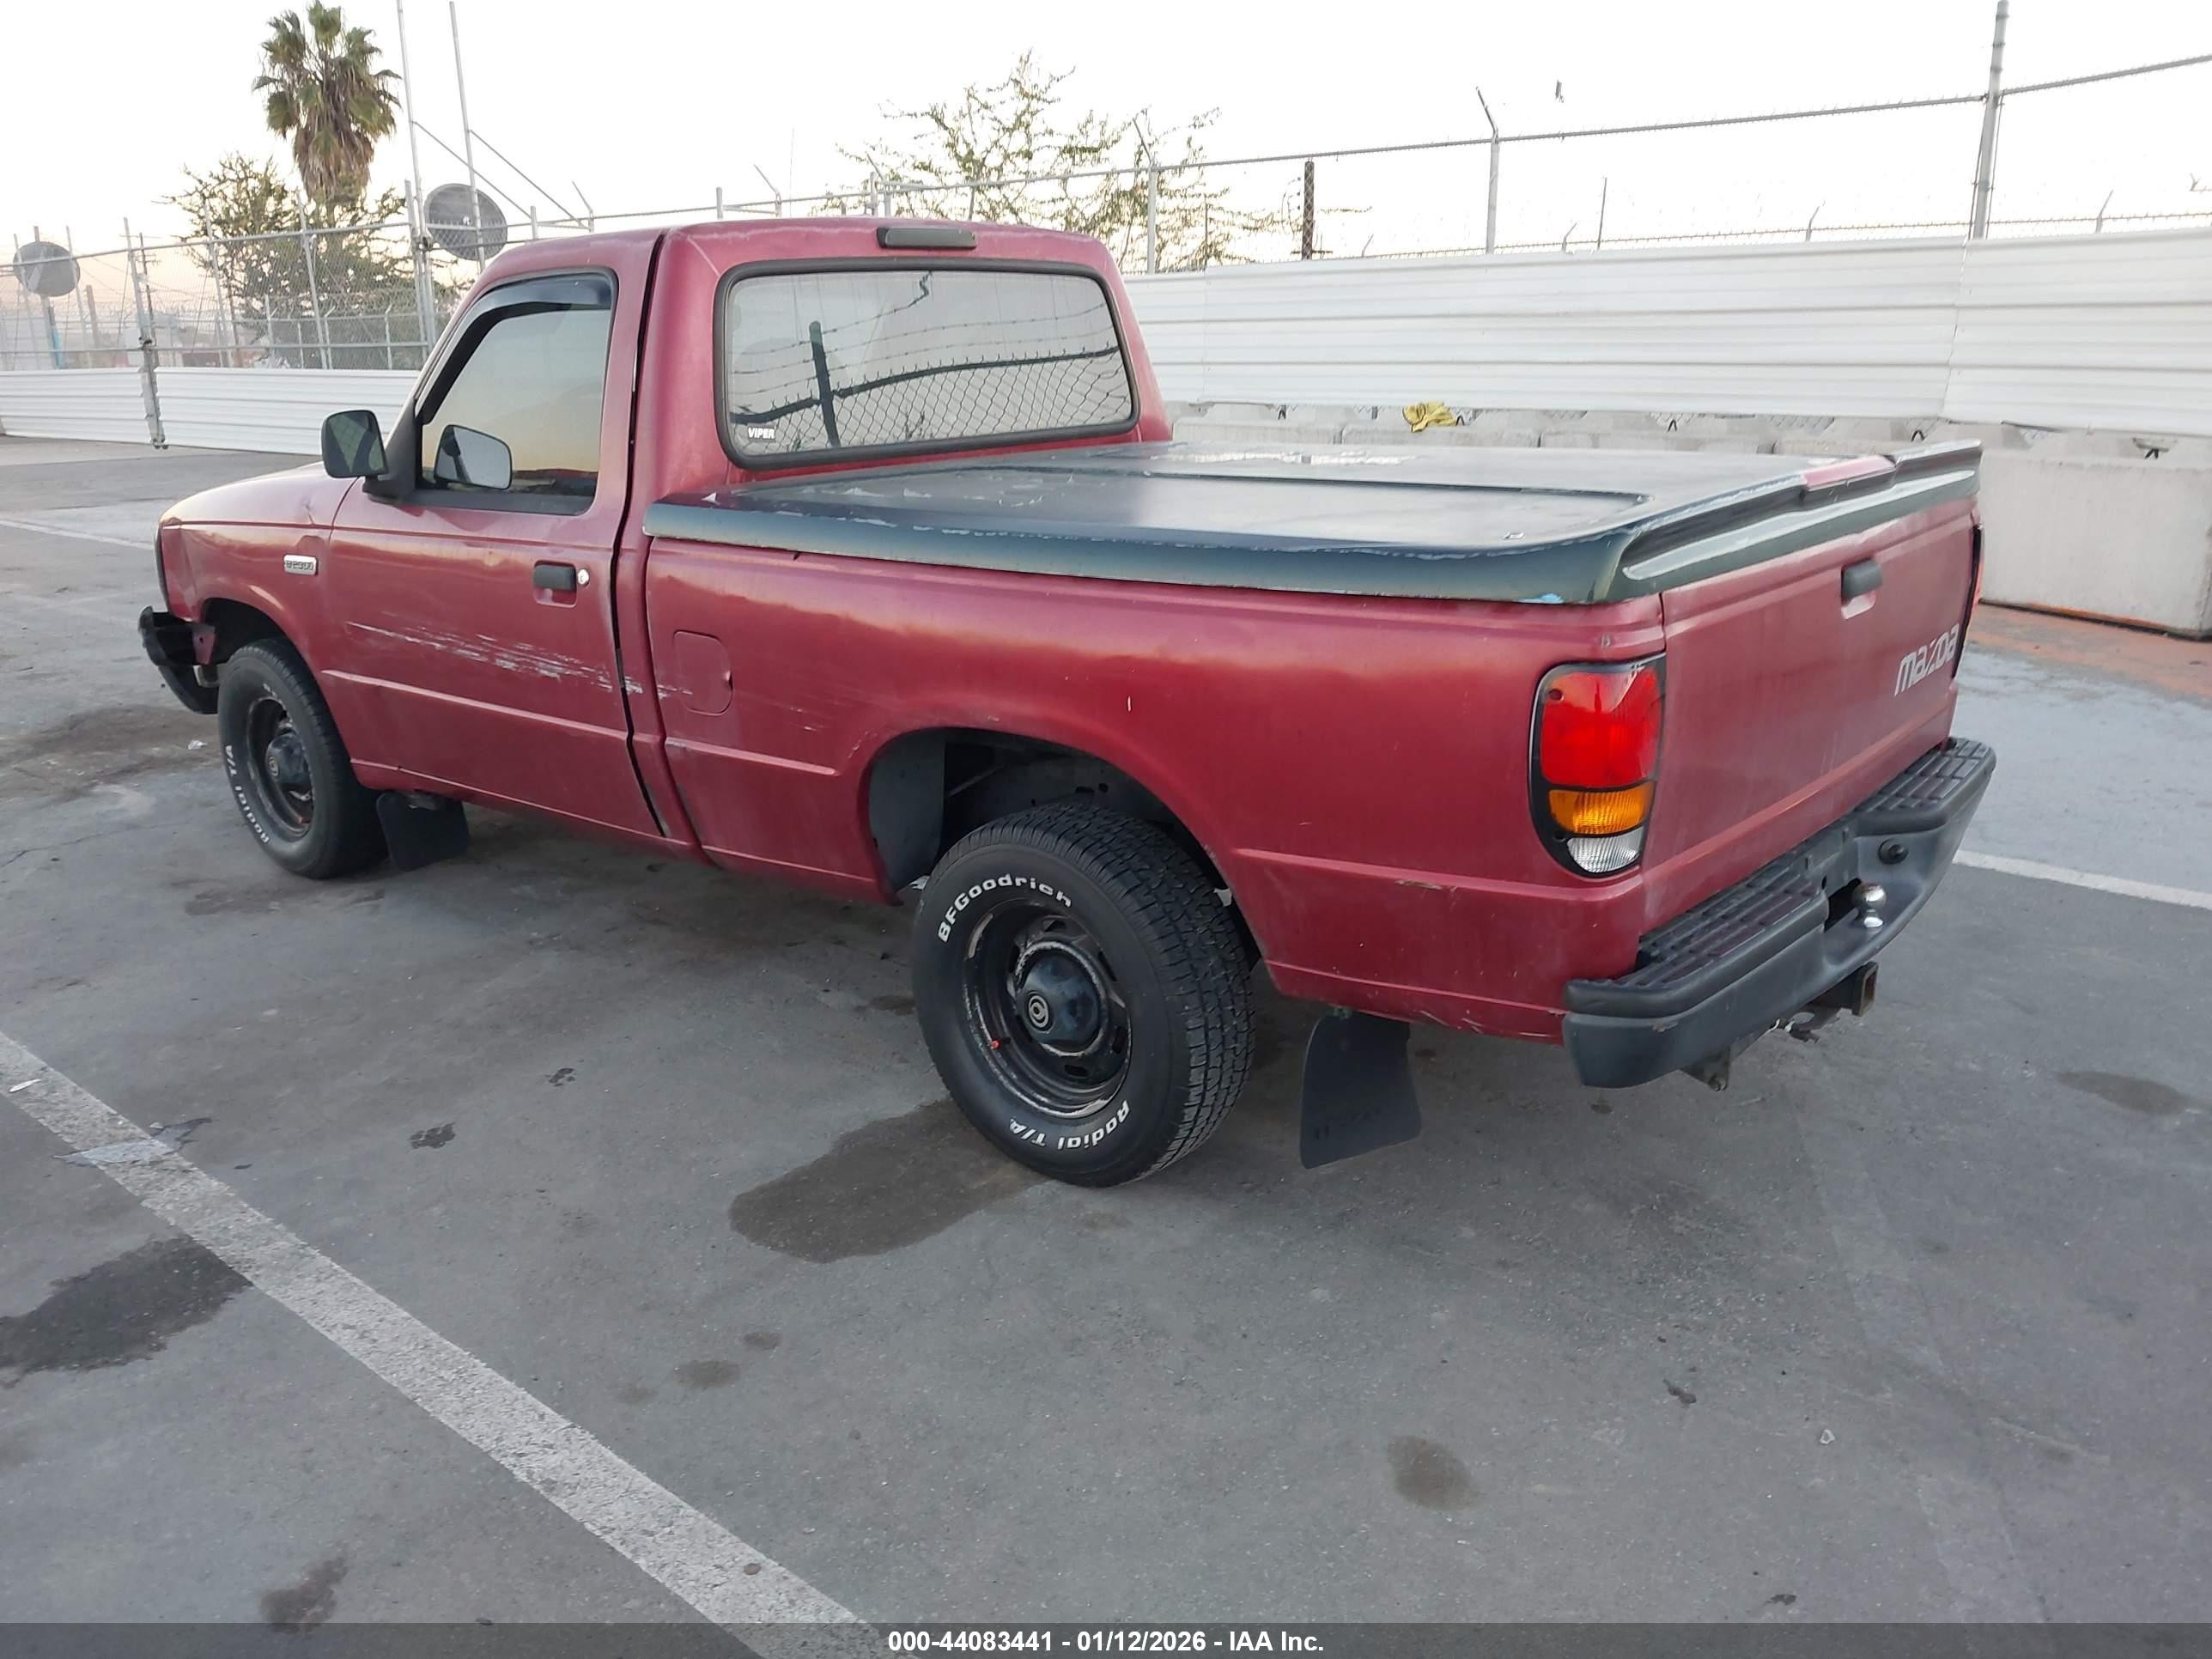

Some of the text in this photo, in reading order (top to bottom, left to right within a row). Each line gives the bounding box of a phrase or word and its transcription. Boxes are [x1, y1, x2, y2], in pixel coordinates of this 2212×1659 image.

[748, 427, 775, 440] VIPER
[234, 786, 270, 843] Radial
[938, 873, 1073, 943] BFGoodrich
[1009, 1099, 1130, 1150] Radial T/A
